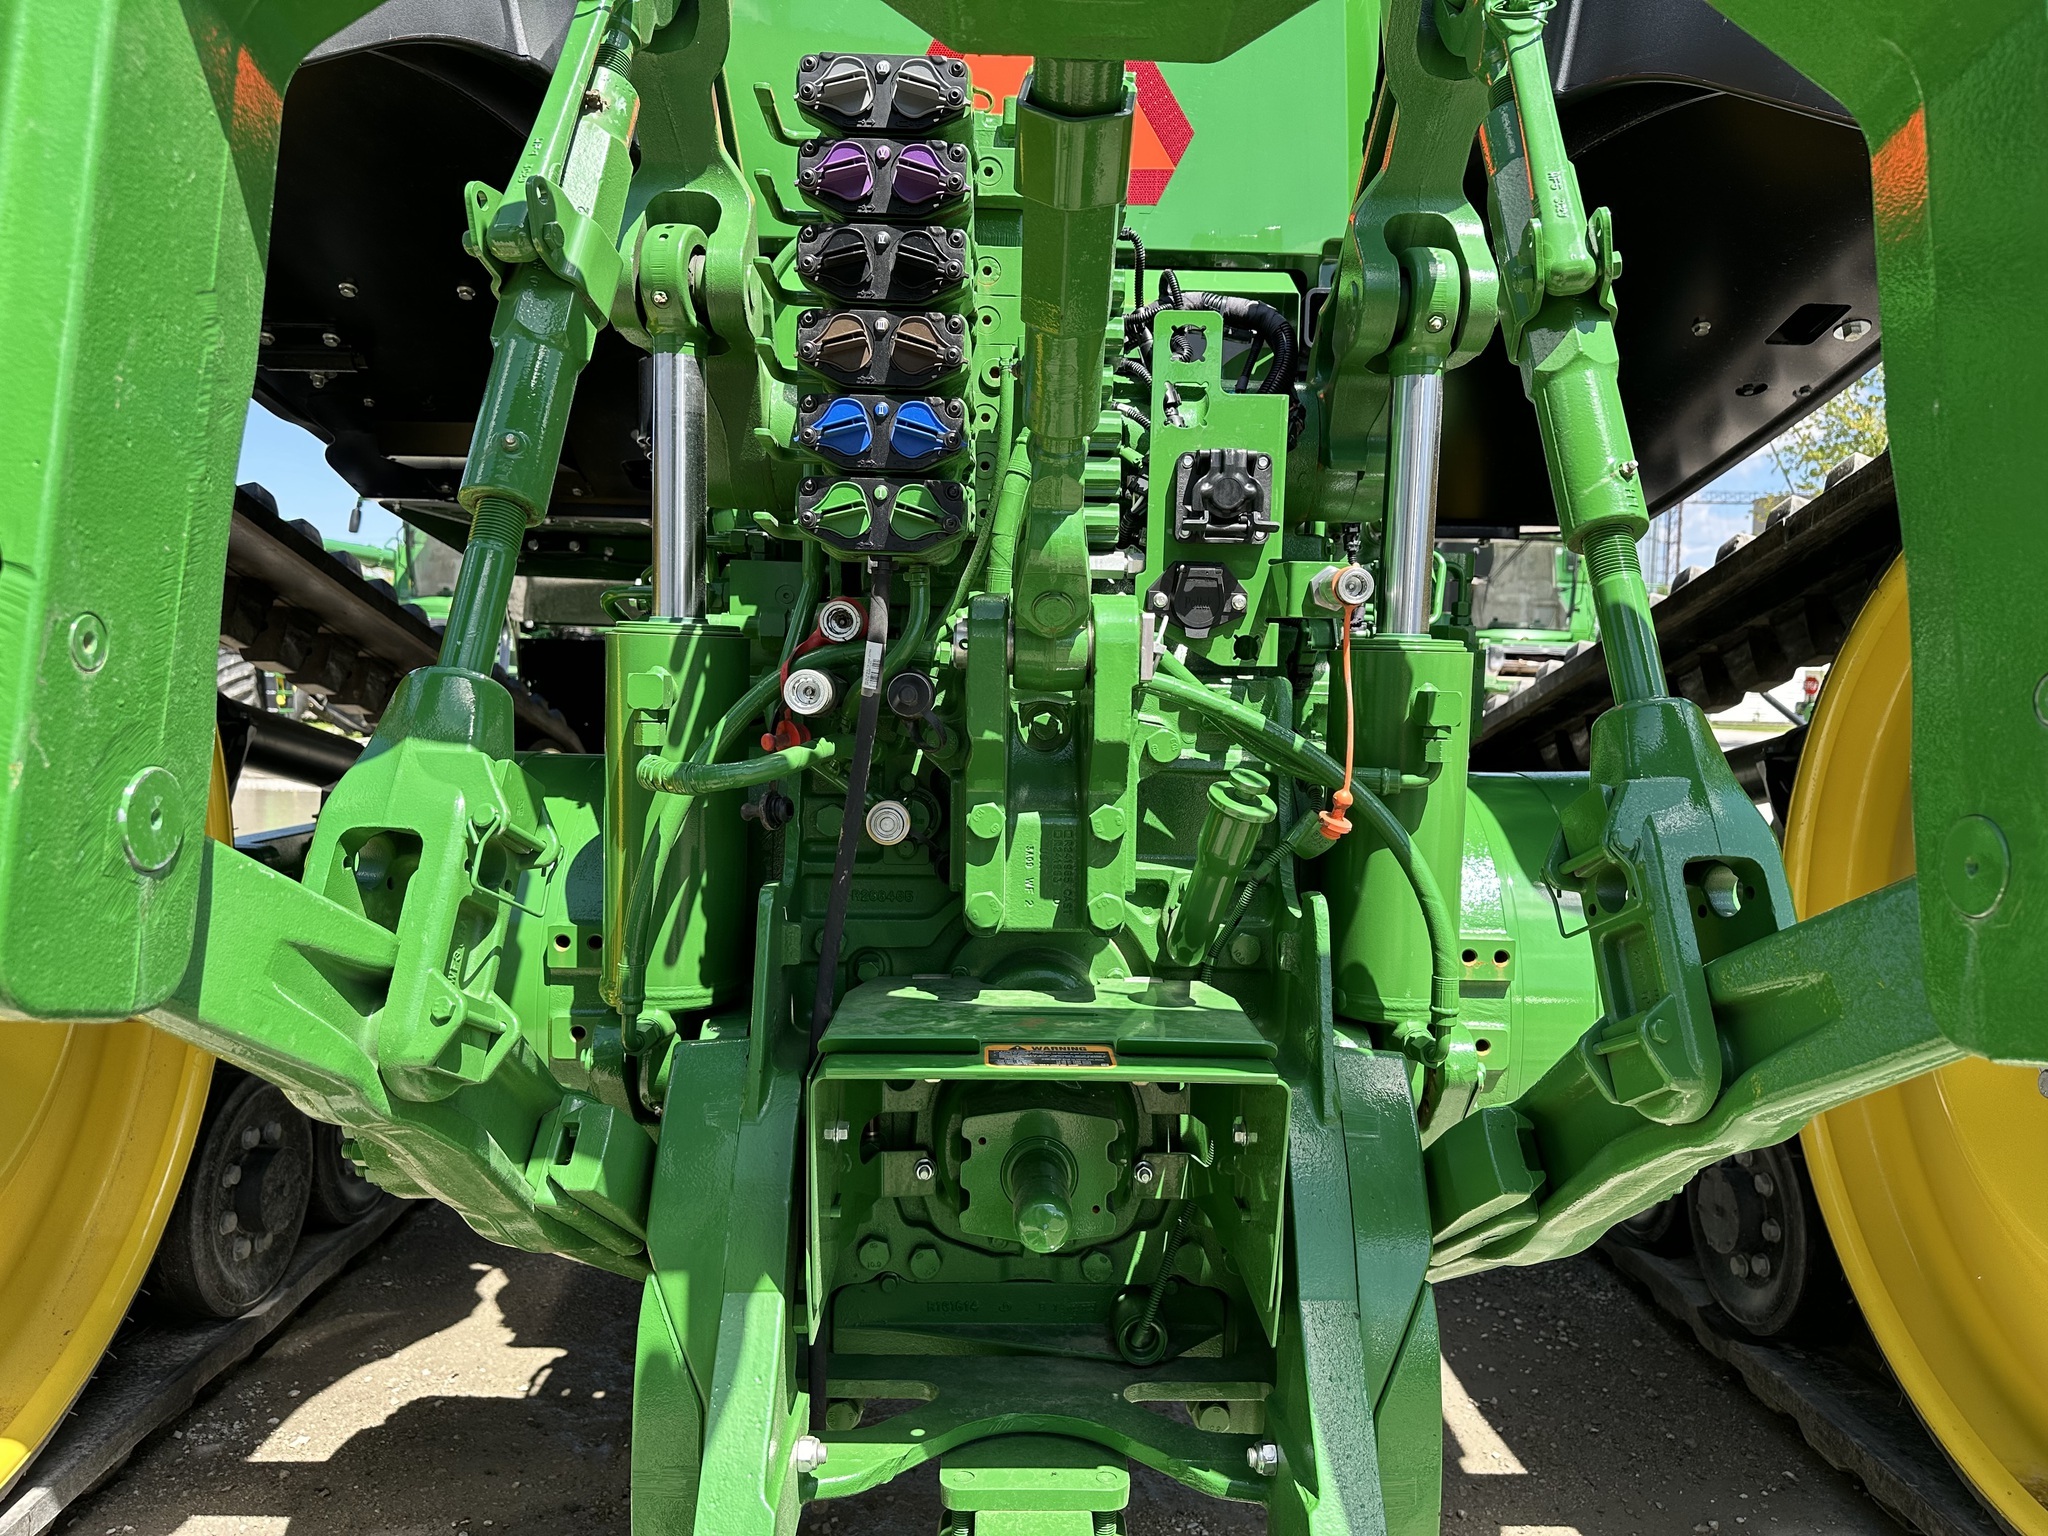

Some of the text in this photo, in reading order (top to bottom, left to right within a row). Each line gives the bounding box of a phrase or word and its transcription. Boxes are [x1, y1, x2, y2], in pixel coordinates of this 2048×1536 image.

[878, 148, 887, 157] V
[878, 234, 886, 244] IV
[877, 320, 885, 329] III
[878, 405, 884, 414] II
[878, 488, 883, 497] I
